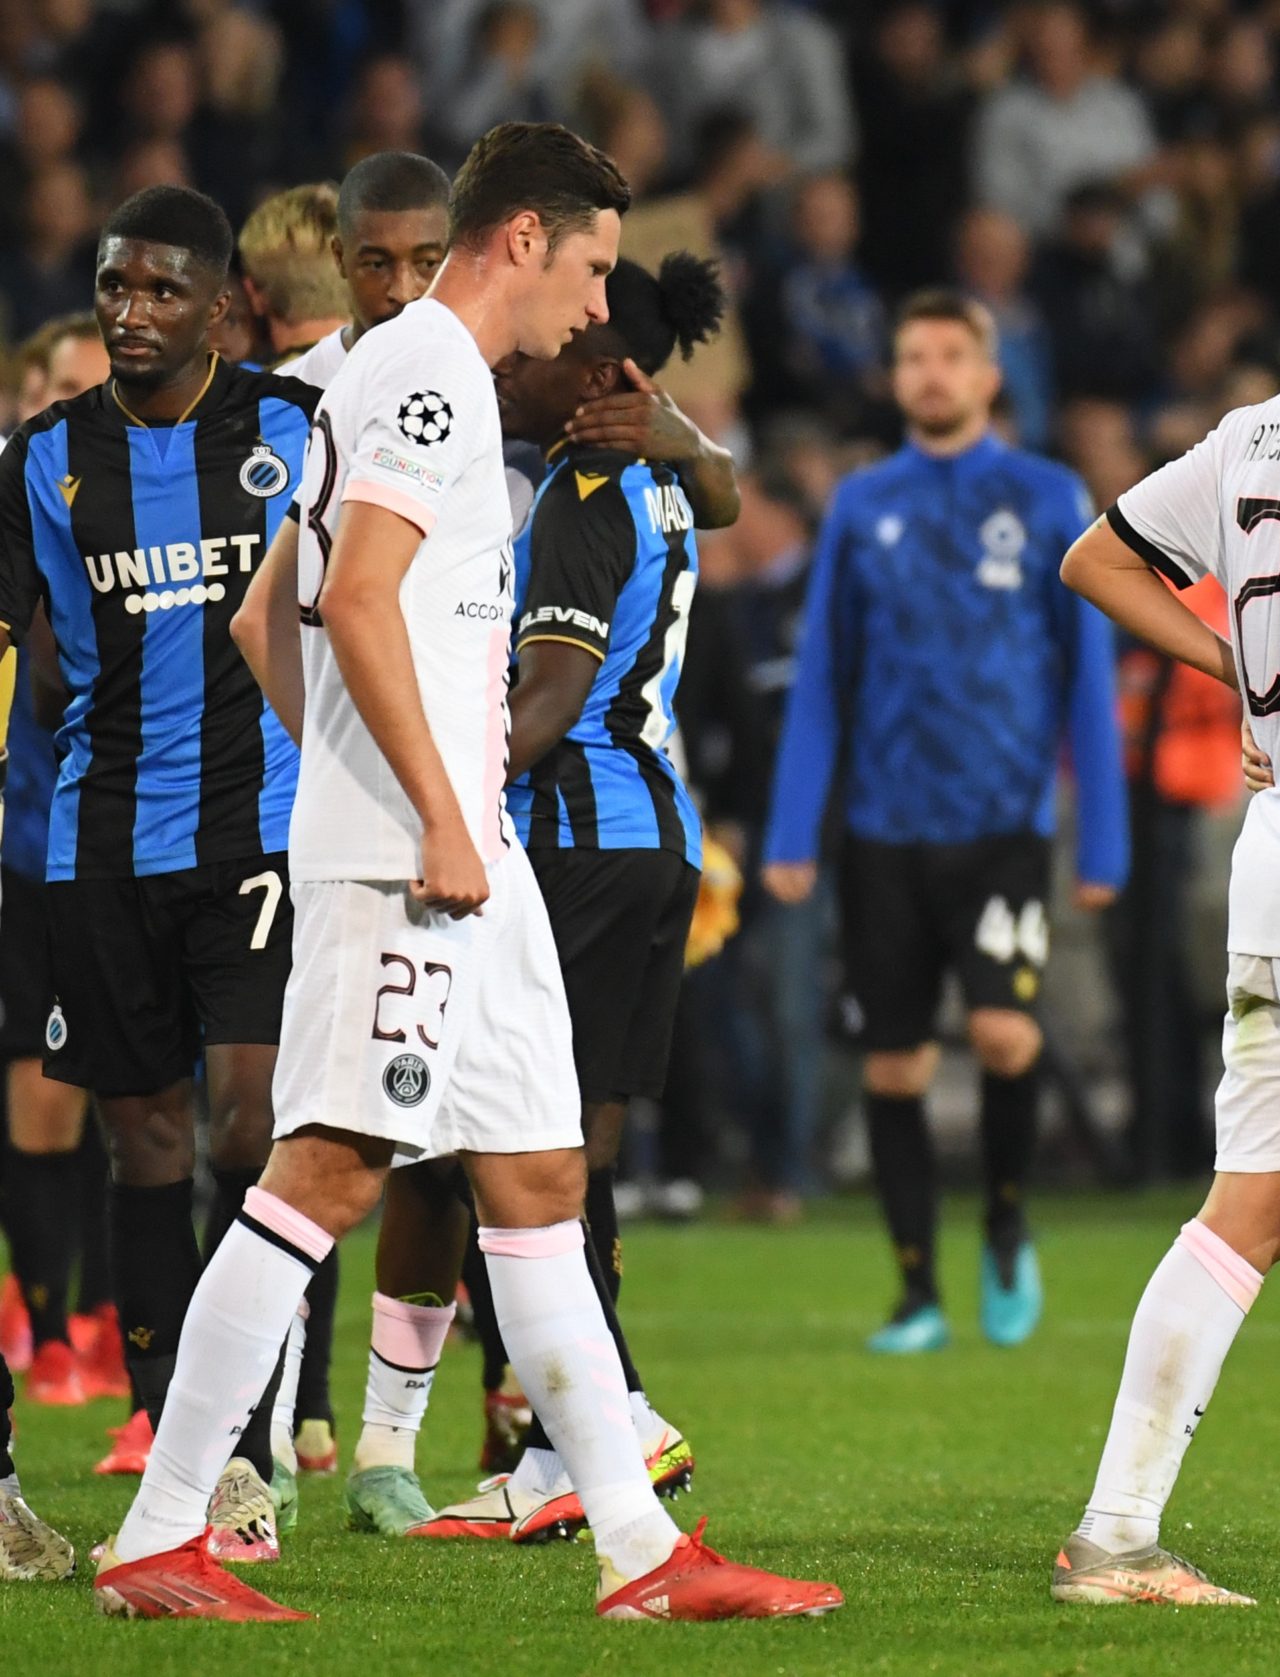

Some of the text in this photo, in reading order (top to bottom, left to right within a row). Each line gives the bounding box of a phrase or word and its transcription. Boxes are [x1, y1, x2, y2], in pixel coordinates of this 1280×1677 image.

[85, 534, 261, 593] UNIBET
[238, 870, 283, 950] 7
[976, 895, 1049, 966] 44
[371, 952, 452, 1051] 23
